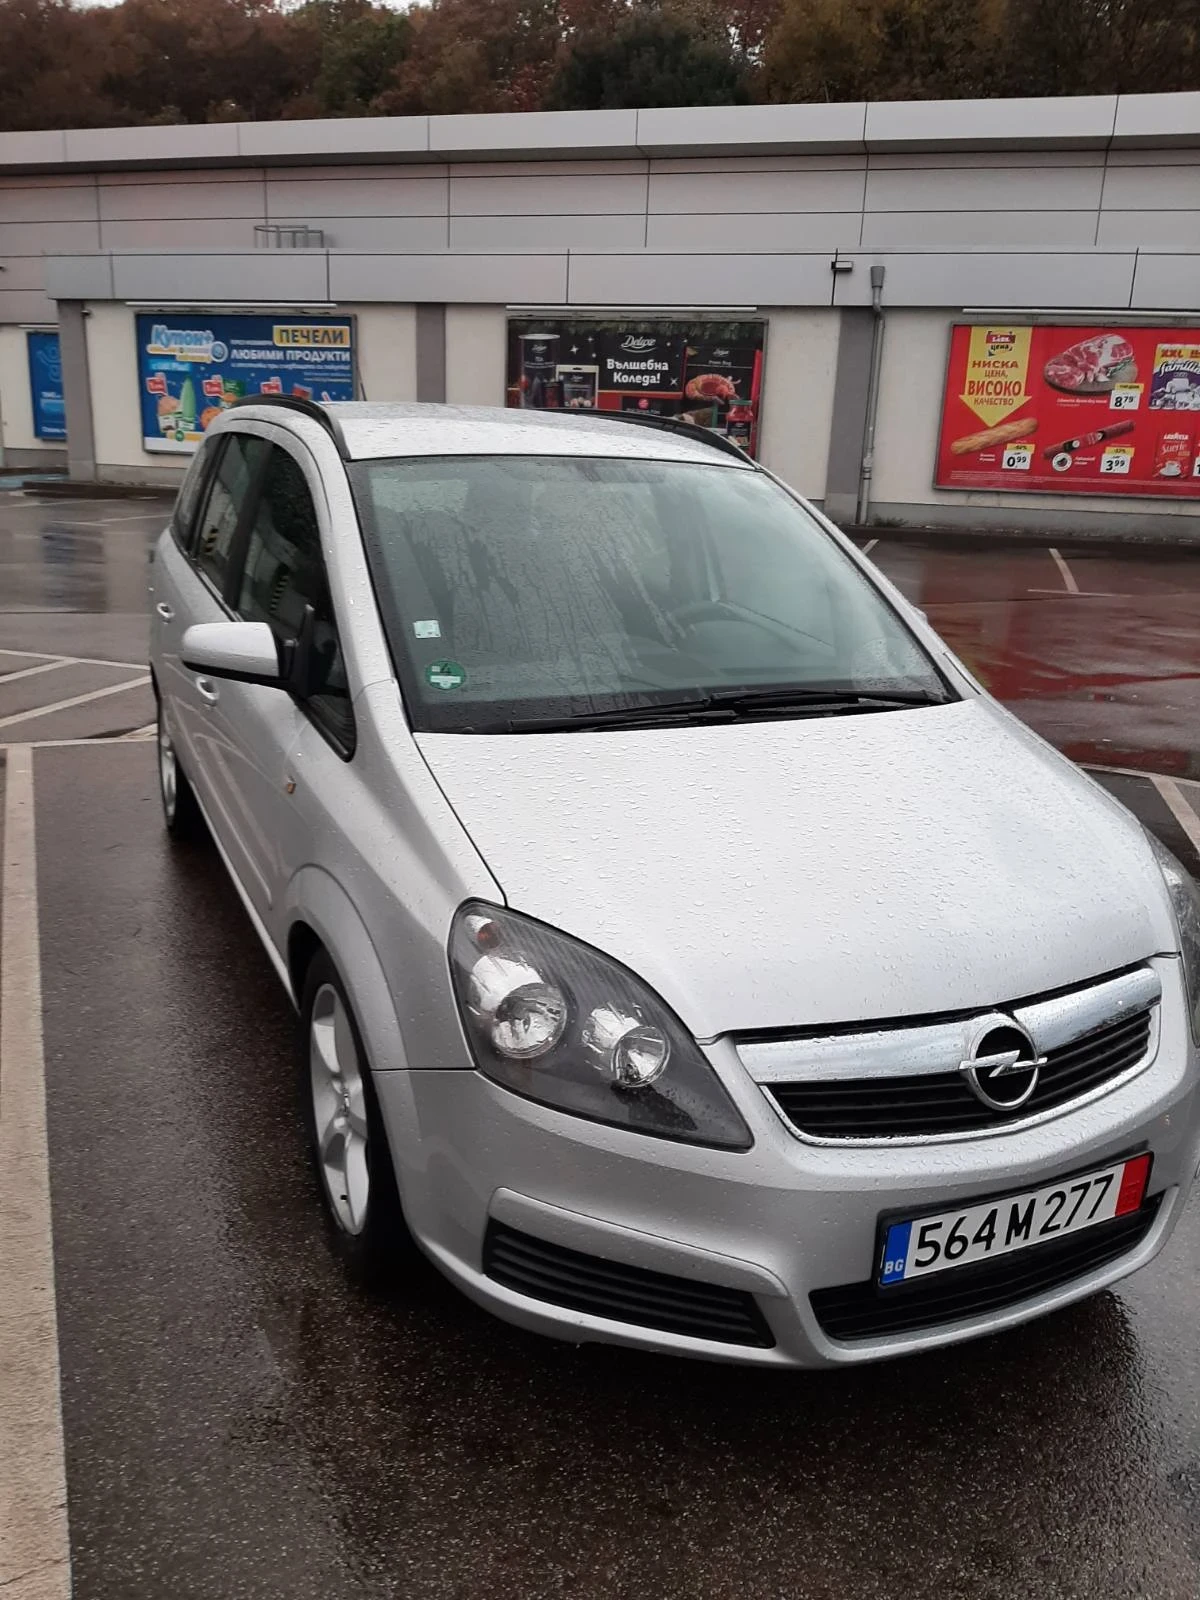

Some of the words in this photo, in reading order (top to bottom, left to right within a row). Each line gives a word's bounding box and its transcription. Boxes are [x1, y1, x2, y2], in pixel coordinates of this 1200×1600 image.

[279, 328, 344, 344] ПЕЧЕЛИ
[621, 335, 657, 351] Deluxe
[230, 349, 284, 360] ЛЮБИМИ
[286, 350, 351, 362] ПРОДУКТИ
[1161, 349, 1184, 358] XXL
[606, 358, 669, 371] Вълшебна
[971, 360, 1019, 368] НИСКА
[613, 372, 661, 386] Коледа!
[984, 369, 1009, 378] ЦЕНА,
[967, 380, 1022, 397] ВИСОКО
[973, 397, 1014, 406] КАЧЕСТВО
[884, 1258, 904, 1275] BG
